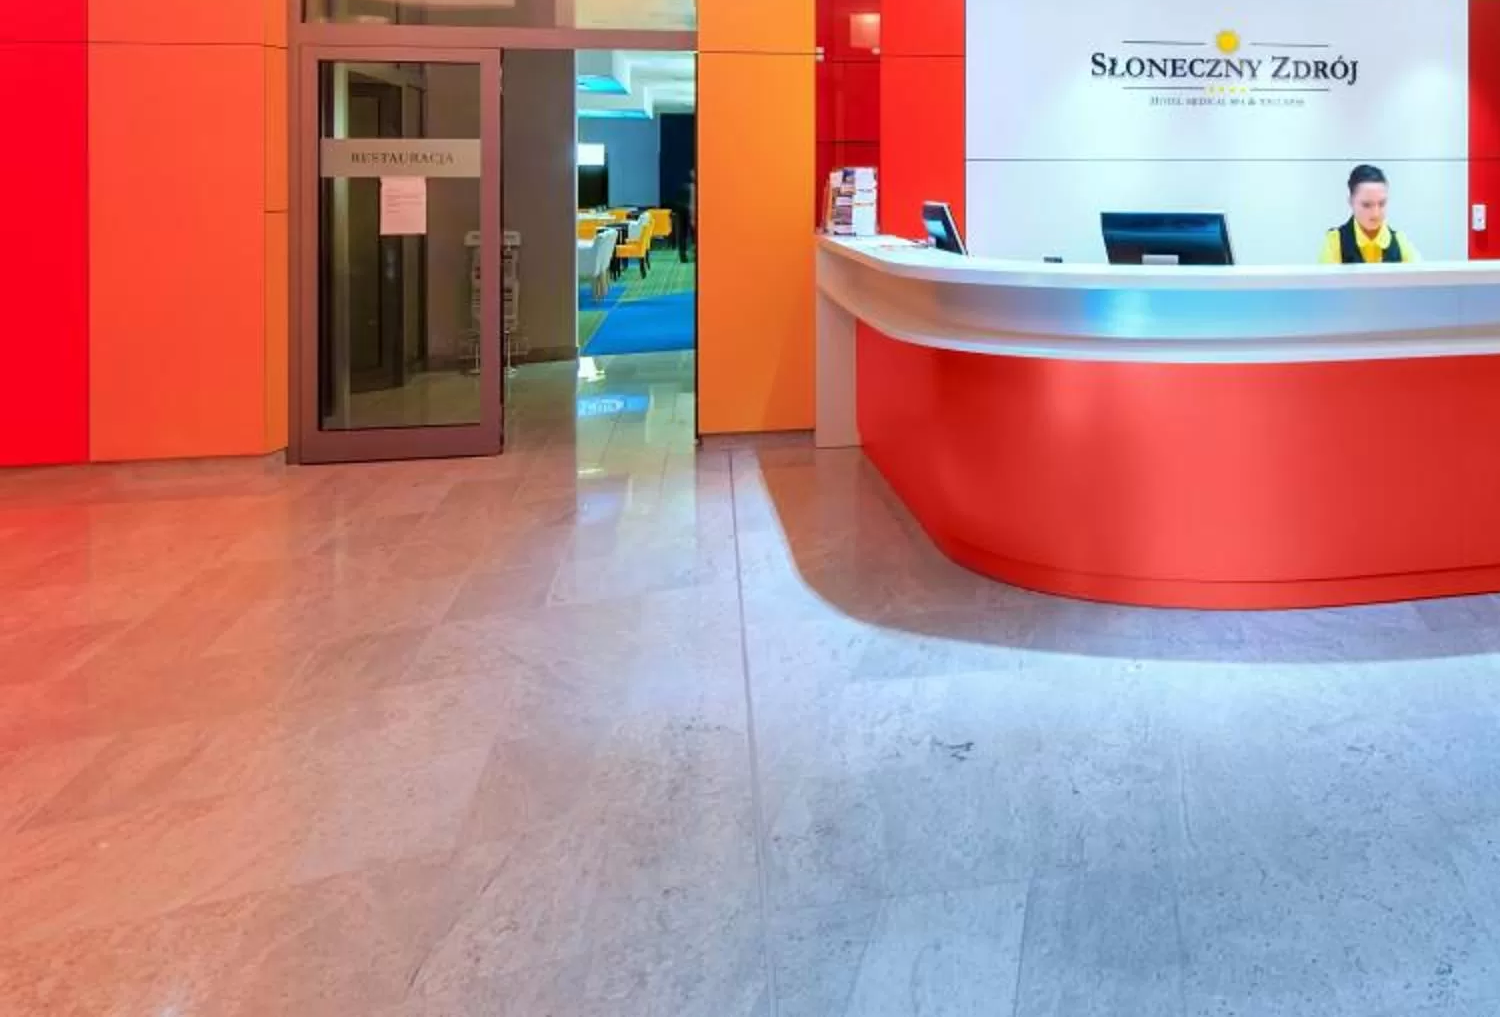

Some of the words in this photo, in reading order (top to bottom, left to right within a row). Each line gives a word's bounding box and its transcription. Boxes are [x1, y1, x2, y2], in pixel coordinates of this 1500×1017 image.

[1091, 52, 1262, 78] SŁONECZNY
[1271, 54, 1359, 85] ZDRÓJ
[351, 150, 455, 165] RESTAURACJA
